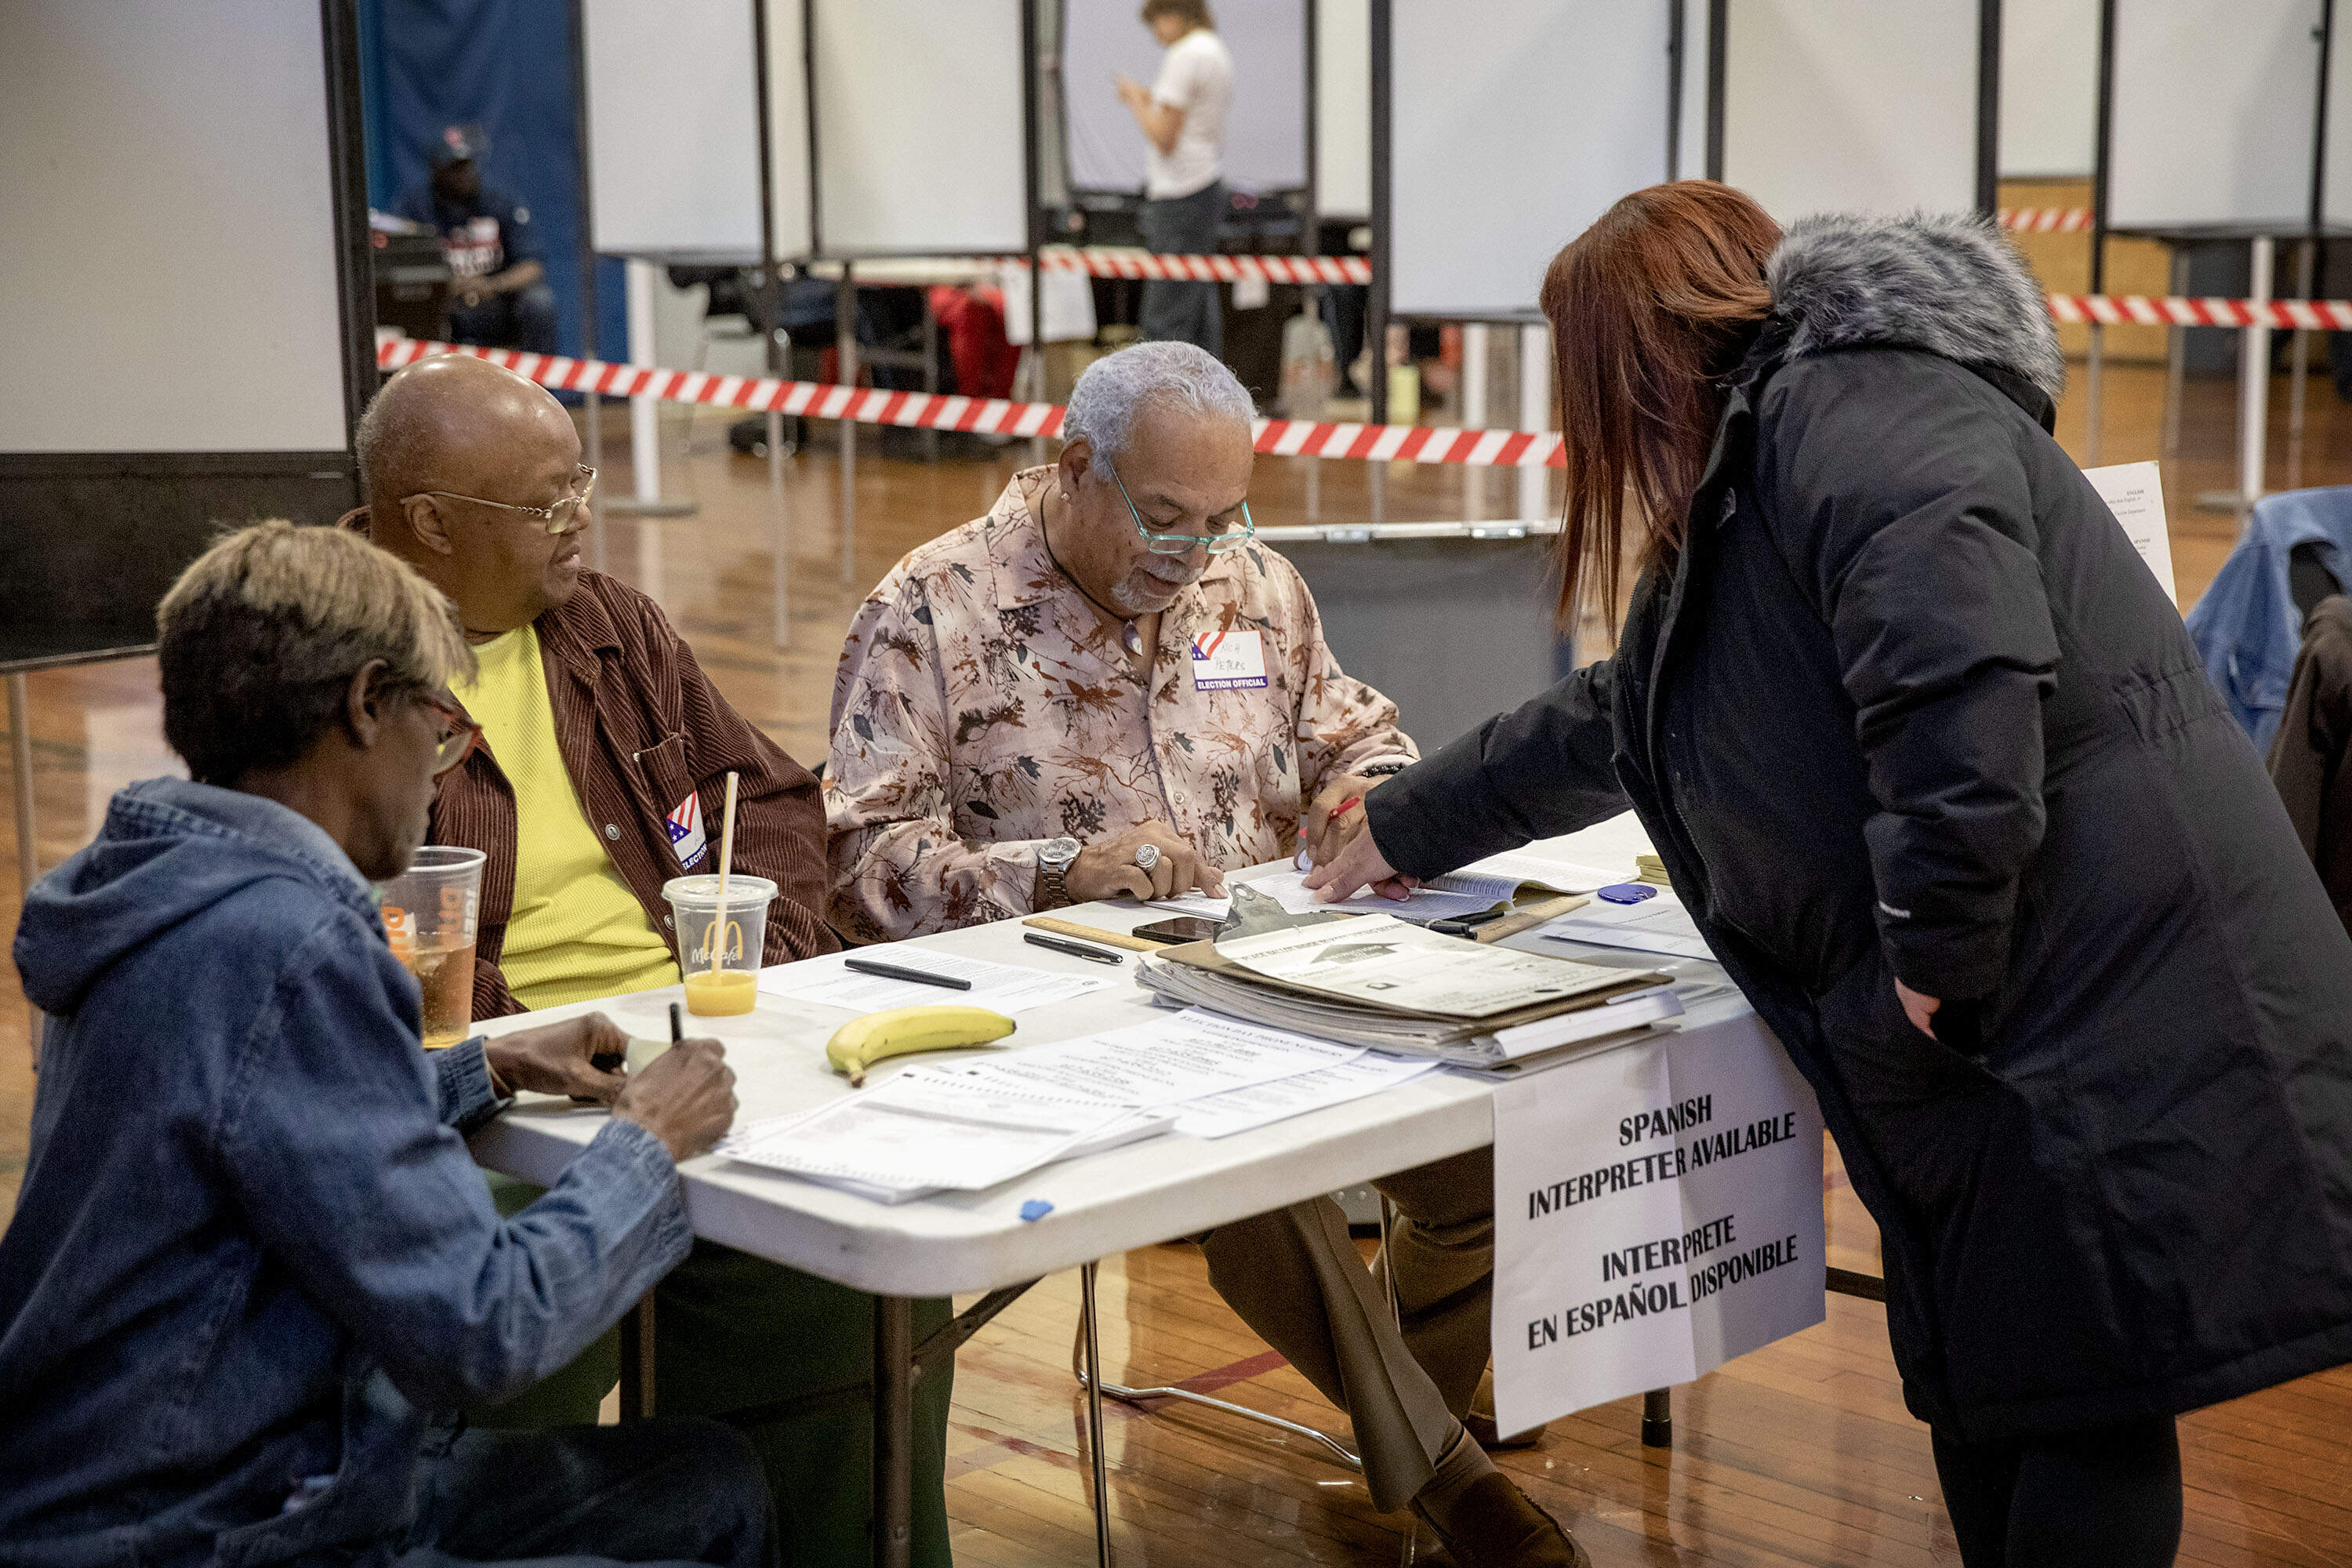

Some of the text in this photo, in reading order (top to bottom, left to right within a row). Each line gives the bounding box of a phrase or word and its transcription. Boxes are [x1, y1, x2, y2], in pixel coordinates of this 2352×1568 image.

[1197, 678, 1266, 689] ELECTION OFFICIAL
[1619, 1094, 1712, 1146] SPANISH
[1529, 1112, 1796, 1220] INTERPRETER AVAILABLE
[1602, 1215, 1737, 1282] INTERPRETE
[1529, 1234, 1798, 1351] EN ESPAÑOL DISPONIBLE
